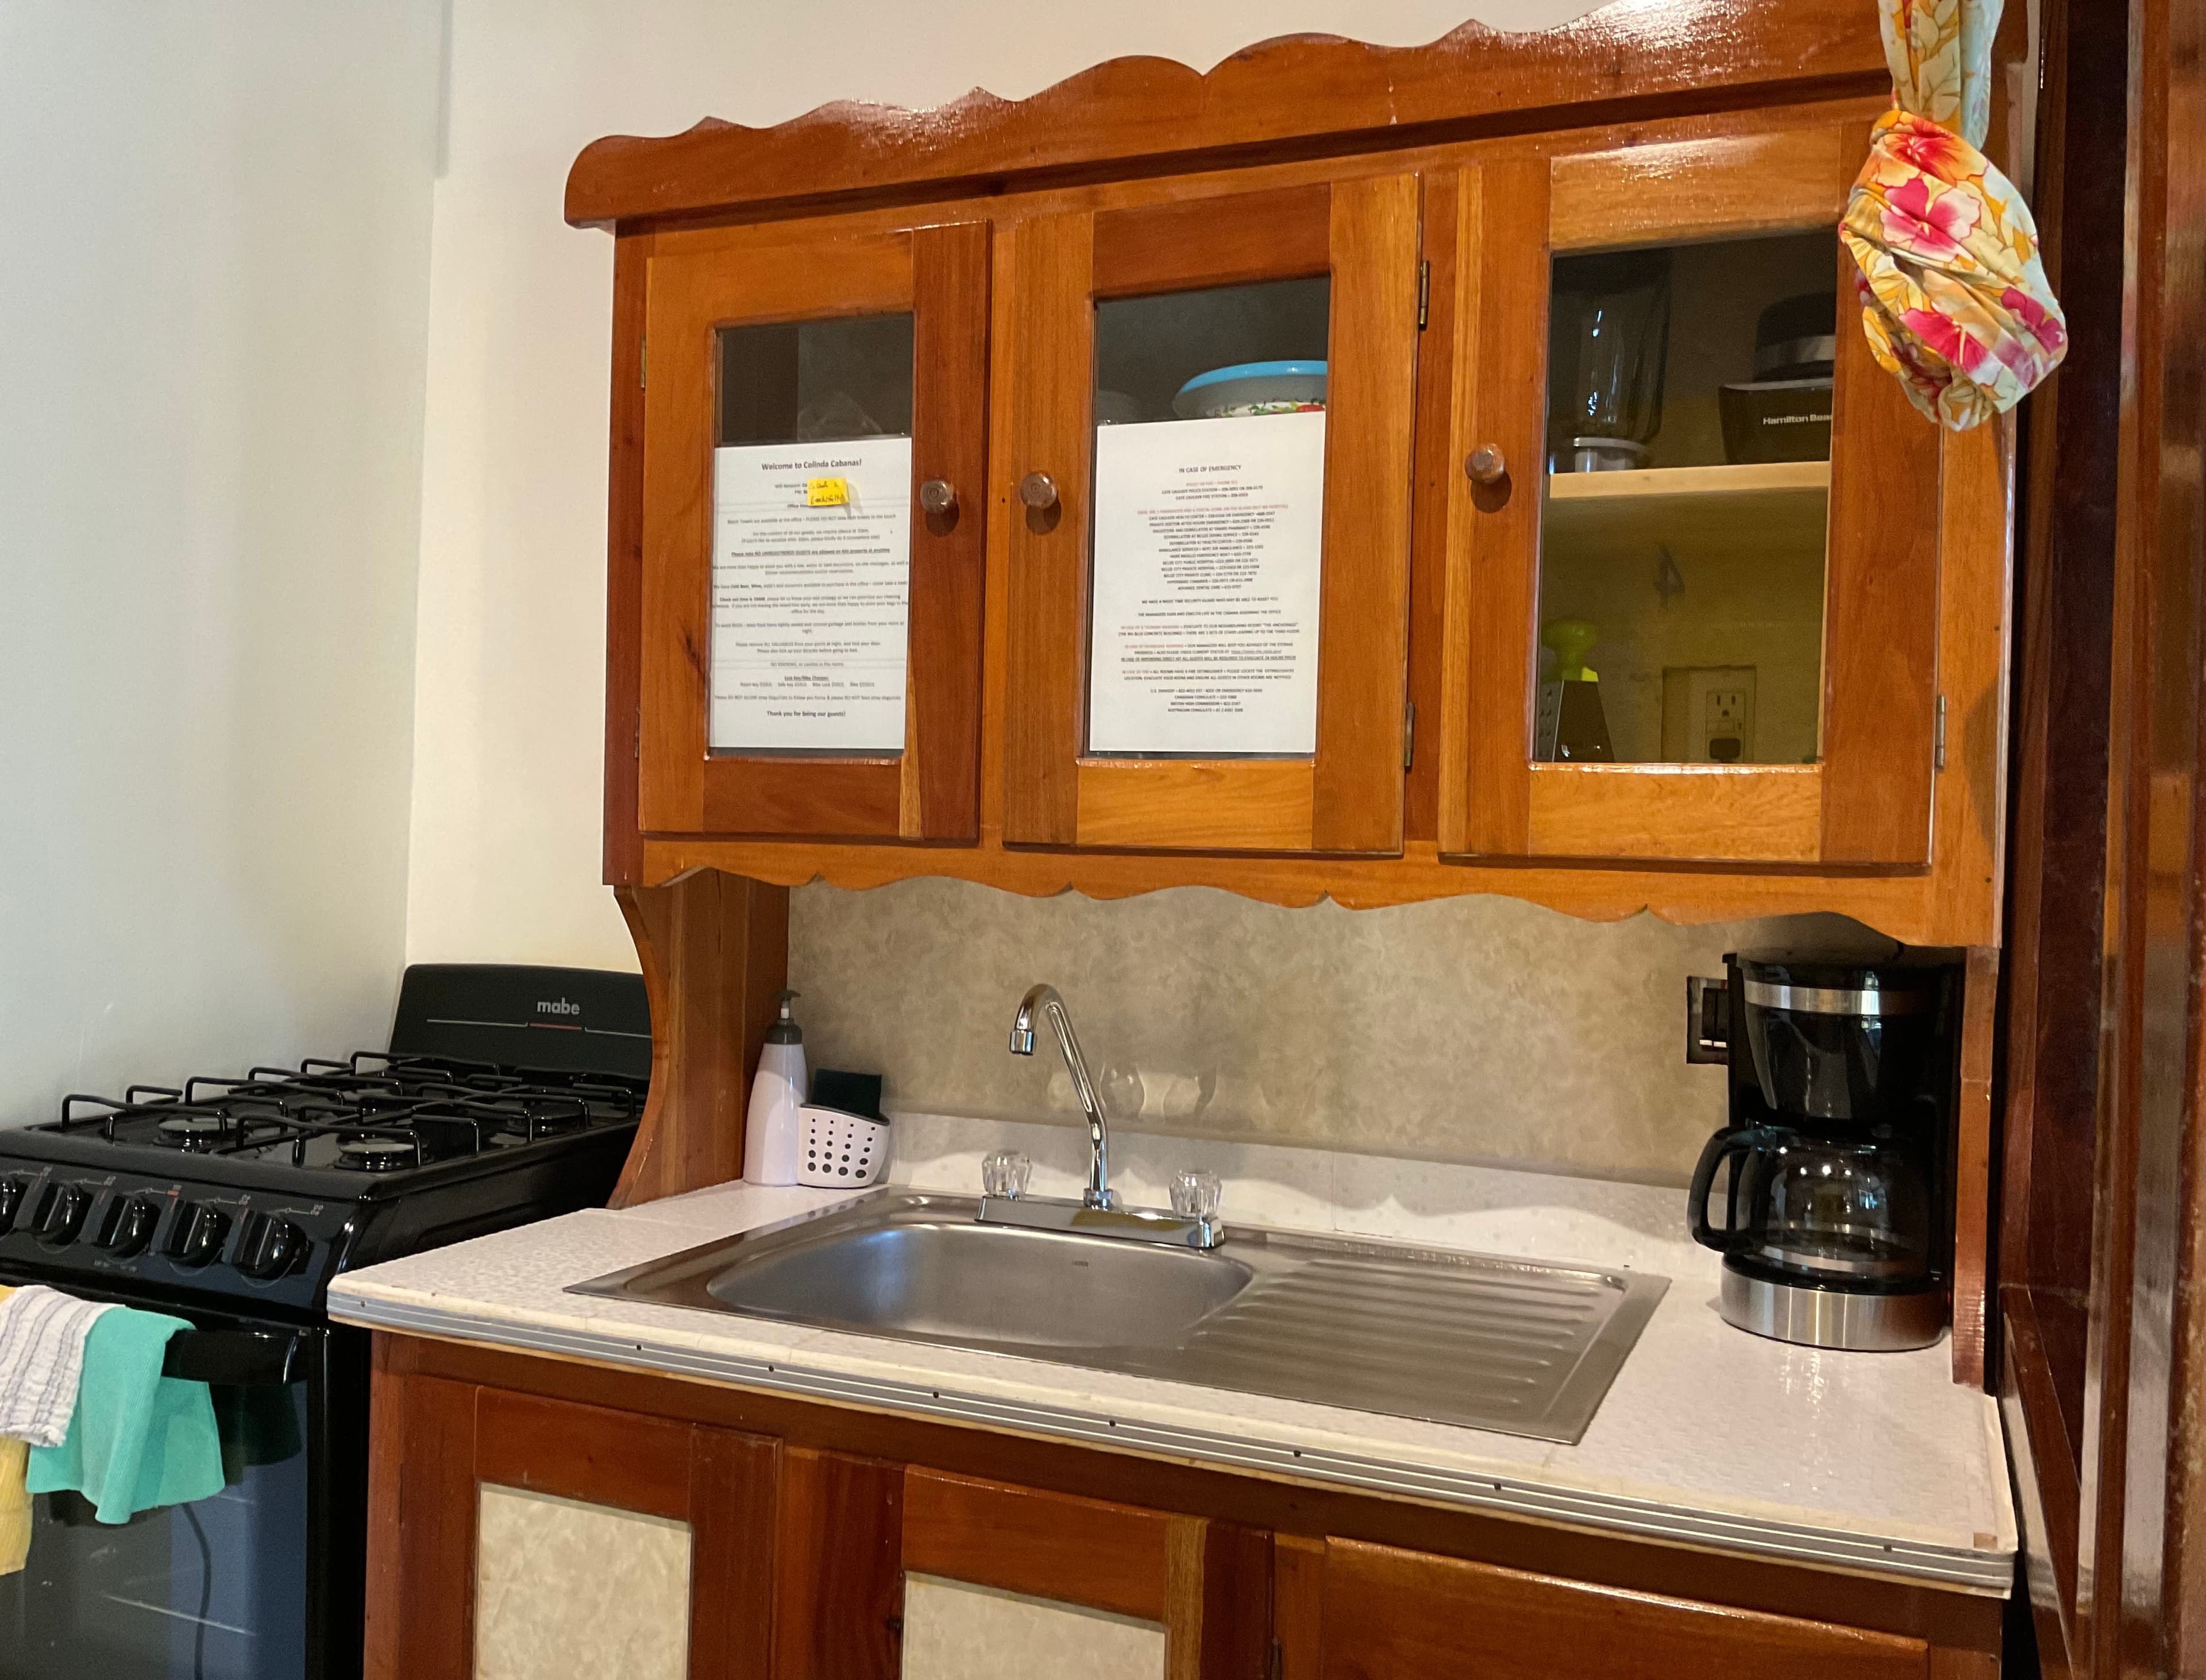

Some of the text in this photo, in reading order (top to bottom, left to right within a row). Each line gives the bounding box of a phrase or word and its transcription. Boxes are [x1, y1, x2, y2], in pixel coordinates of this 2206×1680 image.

[1763, 416, 1808, 424] Hamilton
[803, 460, 829, 469] Colinda
[830, 459, 862, 467] Cabanas!
[537, 997, 580, 1015] mabe
